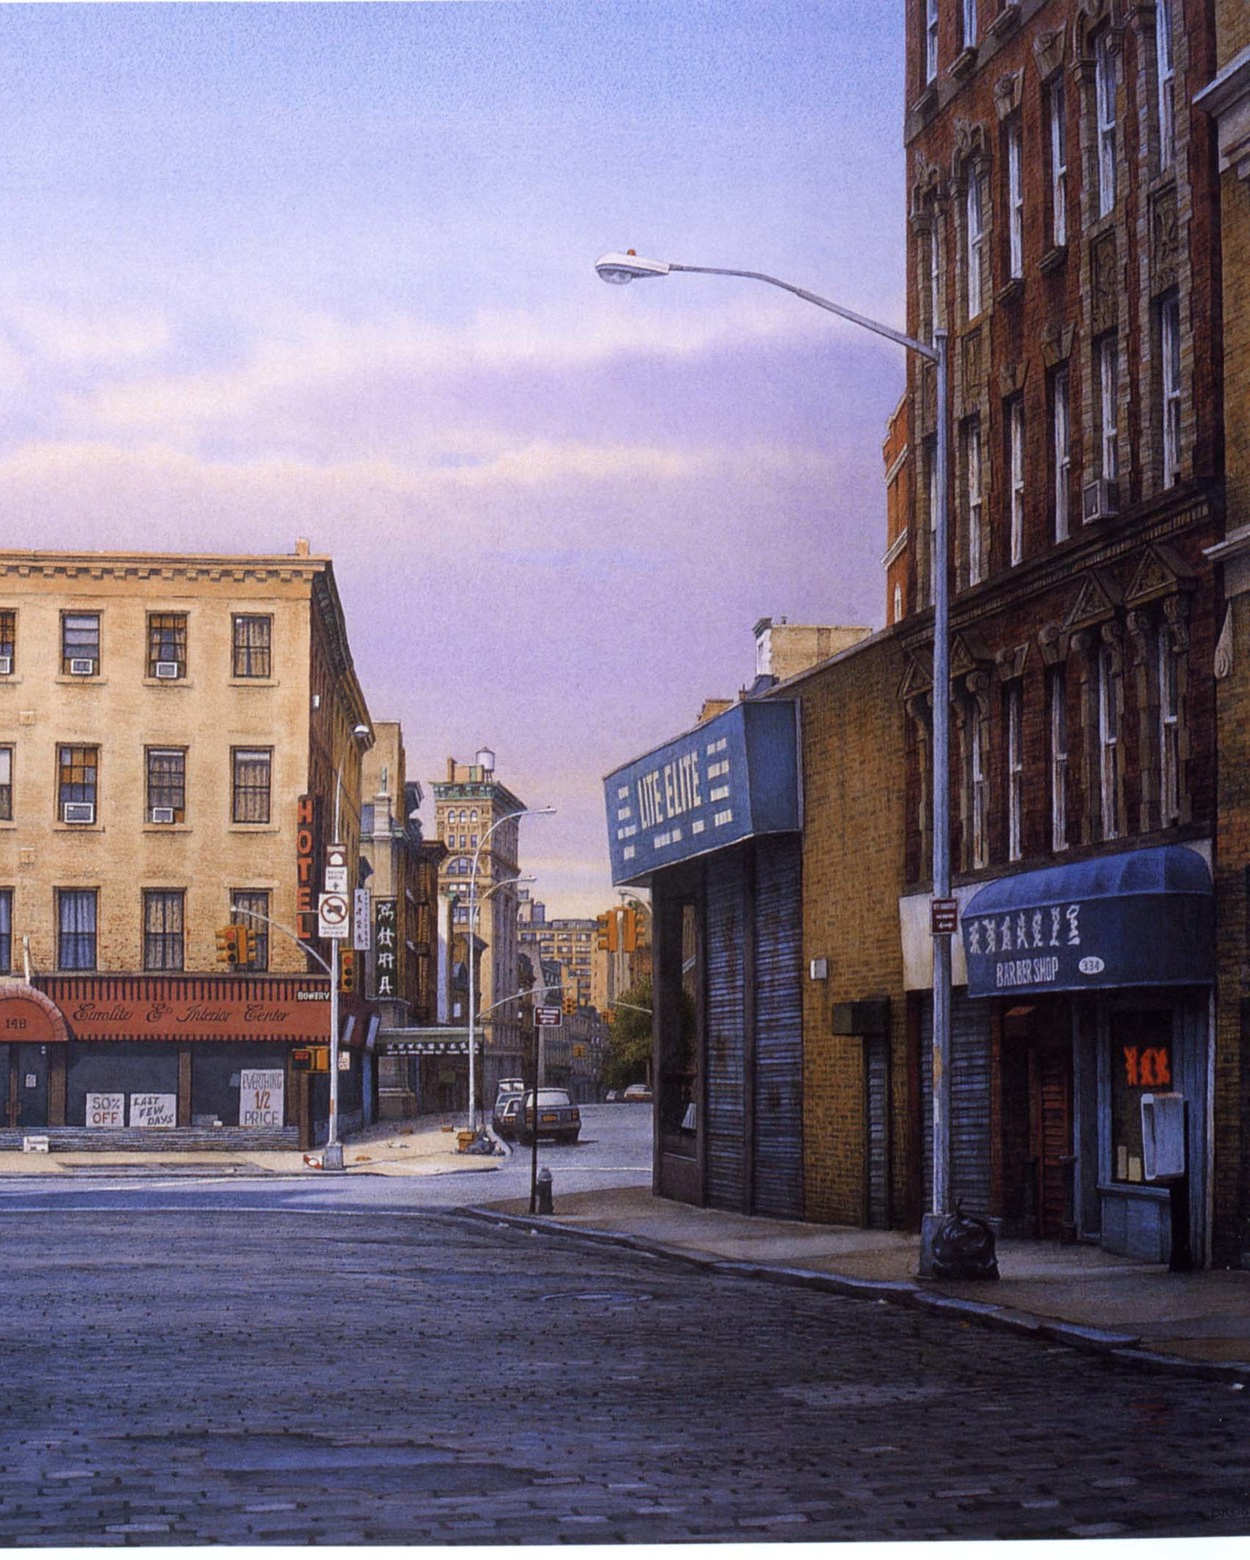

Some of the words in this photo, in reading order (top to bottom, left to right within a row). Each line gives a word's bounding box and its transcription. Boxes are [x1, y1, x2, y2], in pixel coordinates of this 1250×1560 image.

[637, 770, 663, 830] LITE
[664, 751, 701, 819] ELITE
[296, 799, 313, 939] HOTEL
[996, 961, 1033, 988] BARBER
[1033, 956, 1059, 983] SHOP
[297, 991, 330, 1000] BOWERY
[177, 1003, 233, 1022] Interior
[244, 1003, 290, 1022] Center
[92, 1097, 121, 1109] 50%
[133, 1096, 160, 1107] LAST
[255, 1091, 270, 1109] 1/2
[92, 1112, 119, 1124] OFF
[139, 1105, 164, 1118] FEW
[244, 1111, 280, 1126] PRICE
[147, 1113, 175, 1125] DAYS
